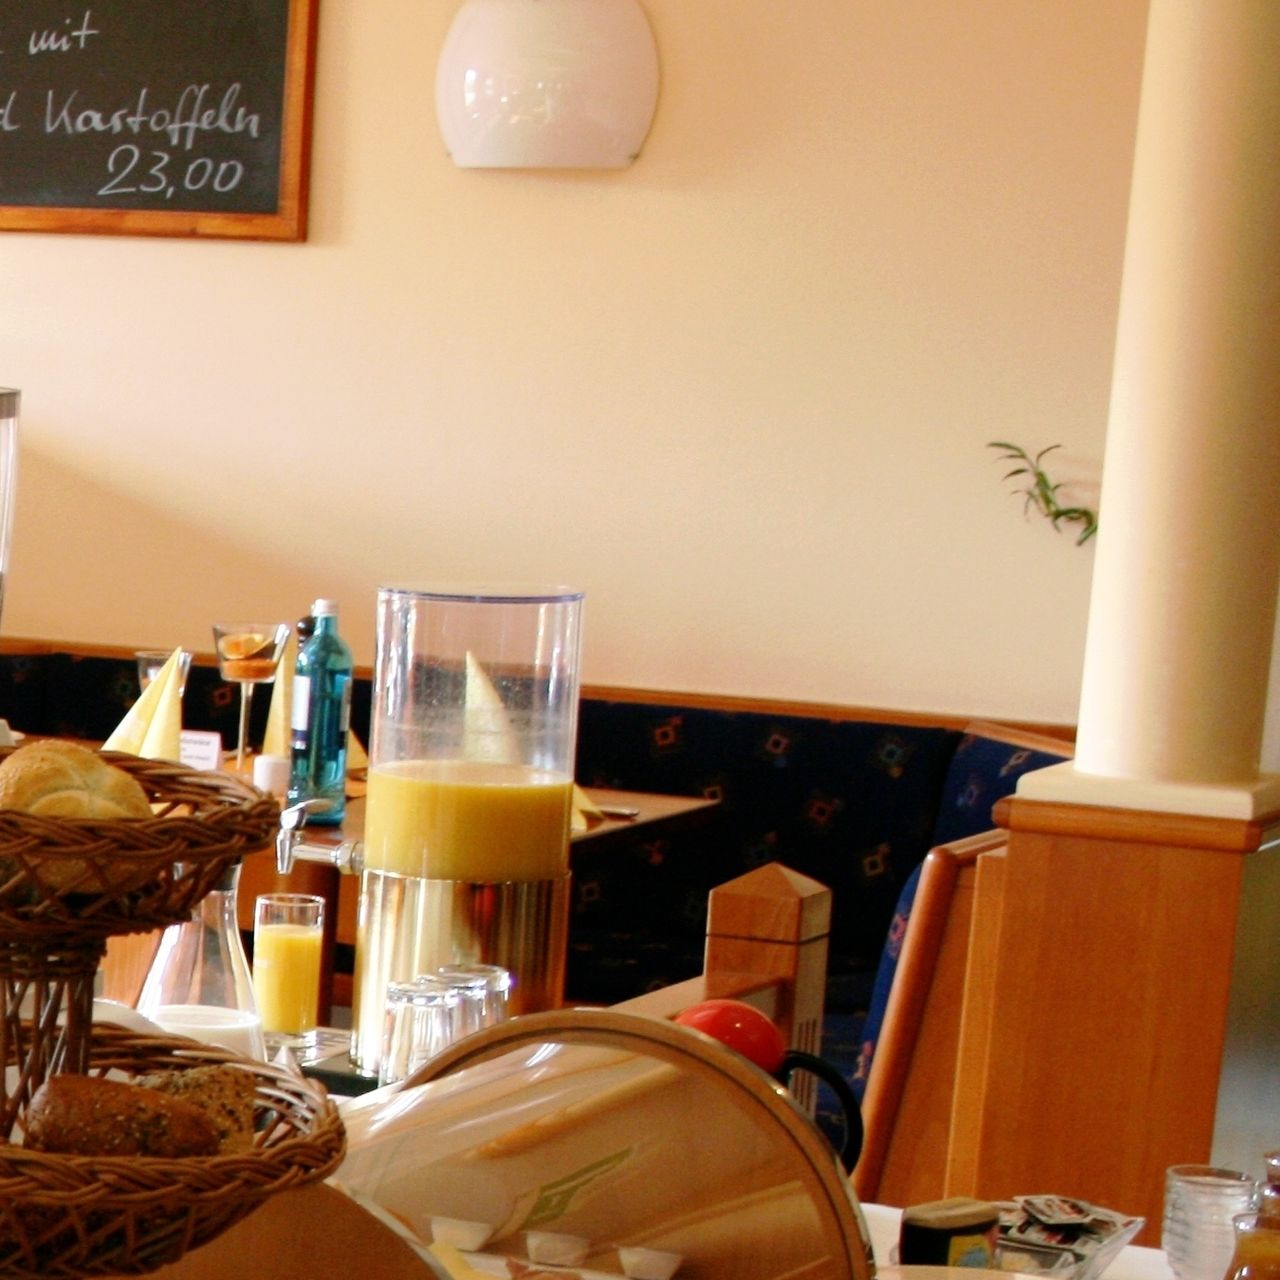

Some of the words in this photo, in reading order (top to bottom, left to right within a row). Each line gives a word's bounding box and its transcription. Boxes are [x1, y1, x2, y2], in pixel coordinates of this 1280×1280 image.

[28, 10, 101, 55] mit
[44, 82, 260, 151] Kartoffeln
[96, 143, 245, 199] 23,00
